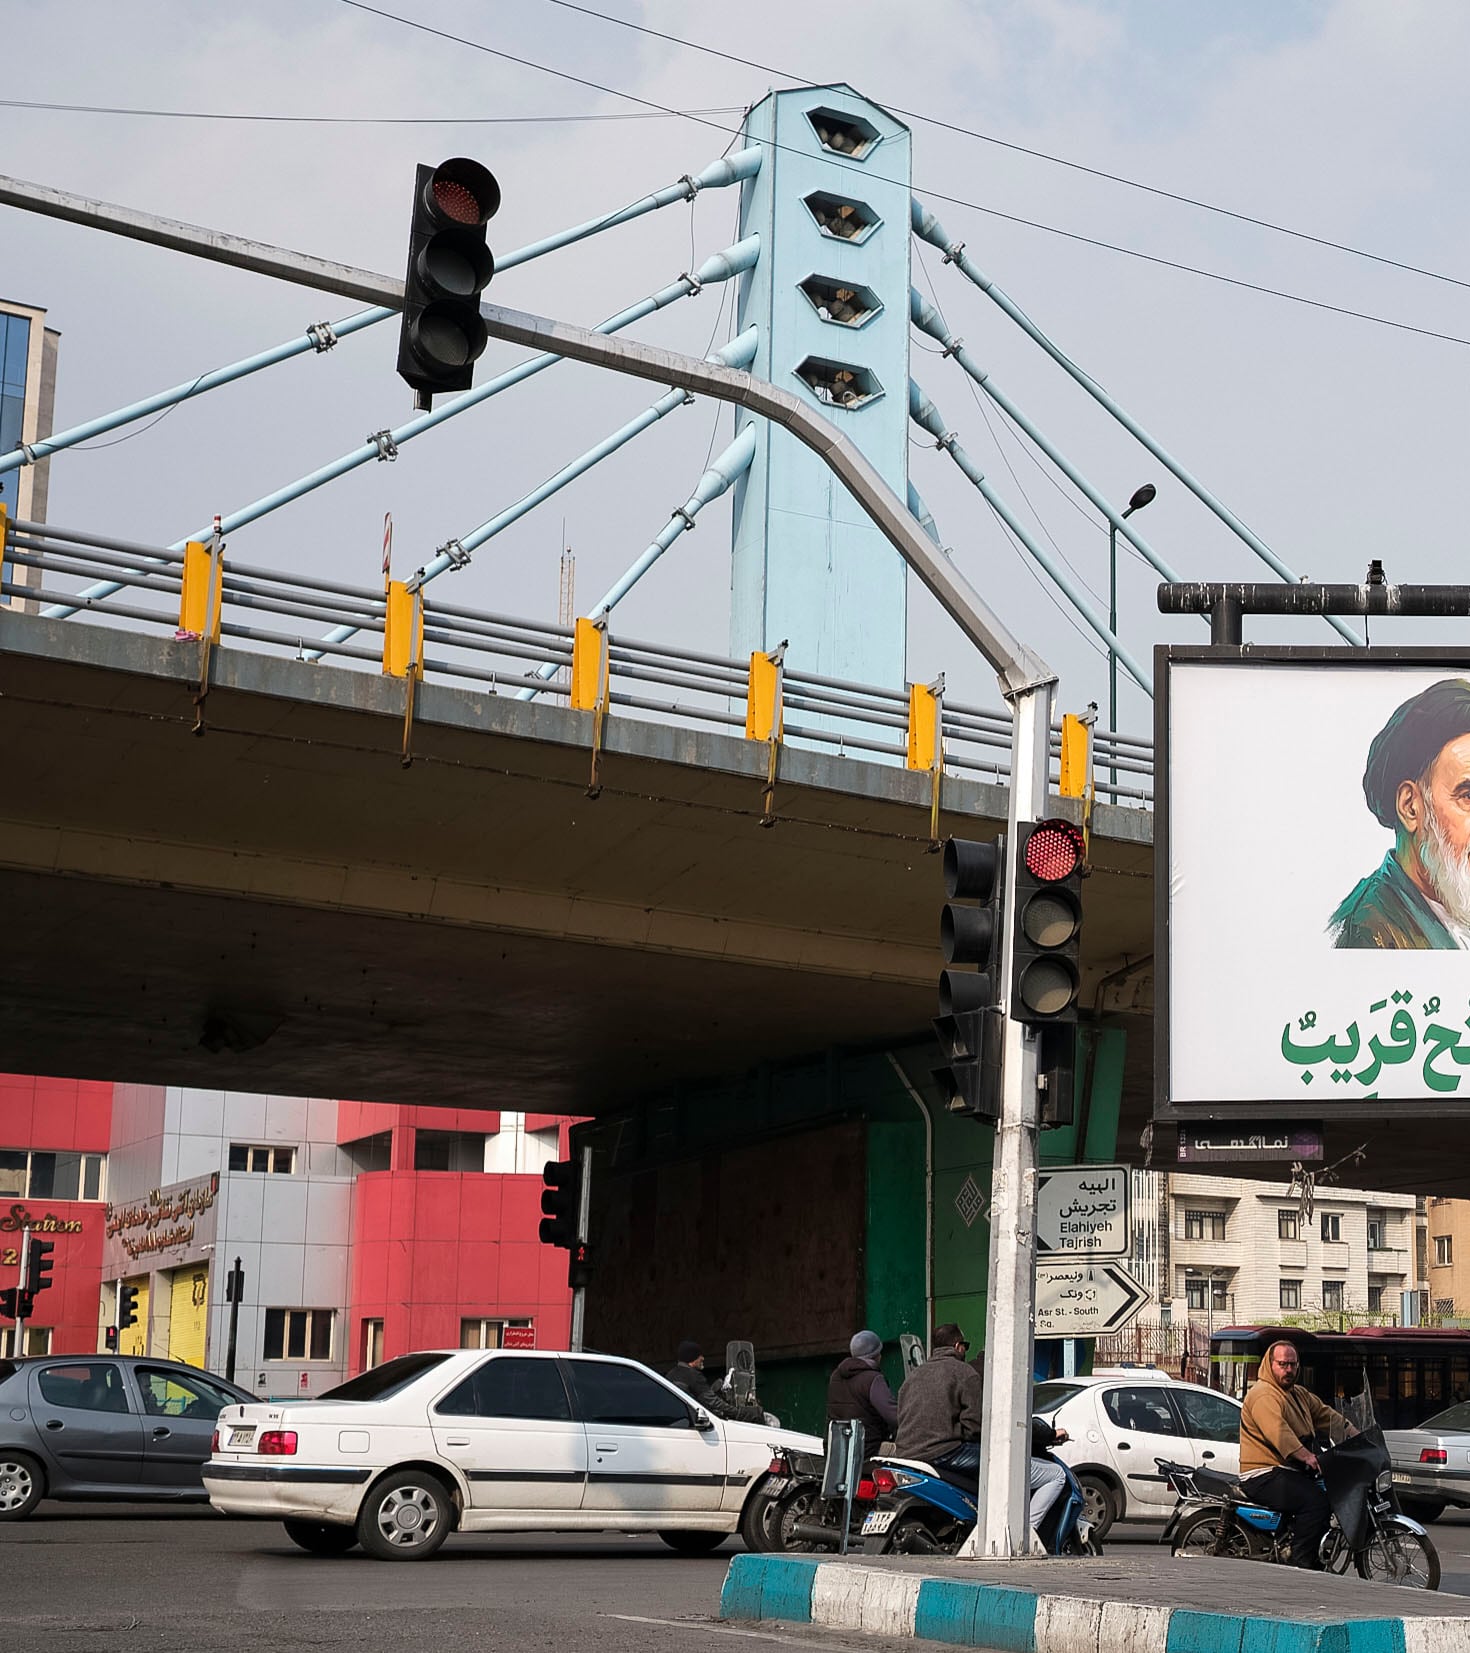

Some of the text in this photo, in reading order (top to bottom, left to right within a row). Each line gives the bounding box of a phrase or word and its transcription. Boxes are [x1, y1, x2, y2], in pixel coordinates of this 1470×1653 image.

[1078, 1178, 1116, 1195] الهیه
[1059, 1198, 1117, 1219] تجریش
[0, 1204, 83, 1233] Station
[1060, 1220, 1113, 1235] Elahiyeh
[1059, 1236, 1102, 1250] Tajrish
[1059, 1289, 1083, 1302] ونک
[1038, 1308, 1052, 1317] Asr
[1055, 1307, 1067, 1317] St.
[1073, 1306, 1099, 1316] South
